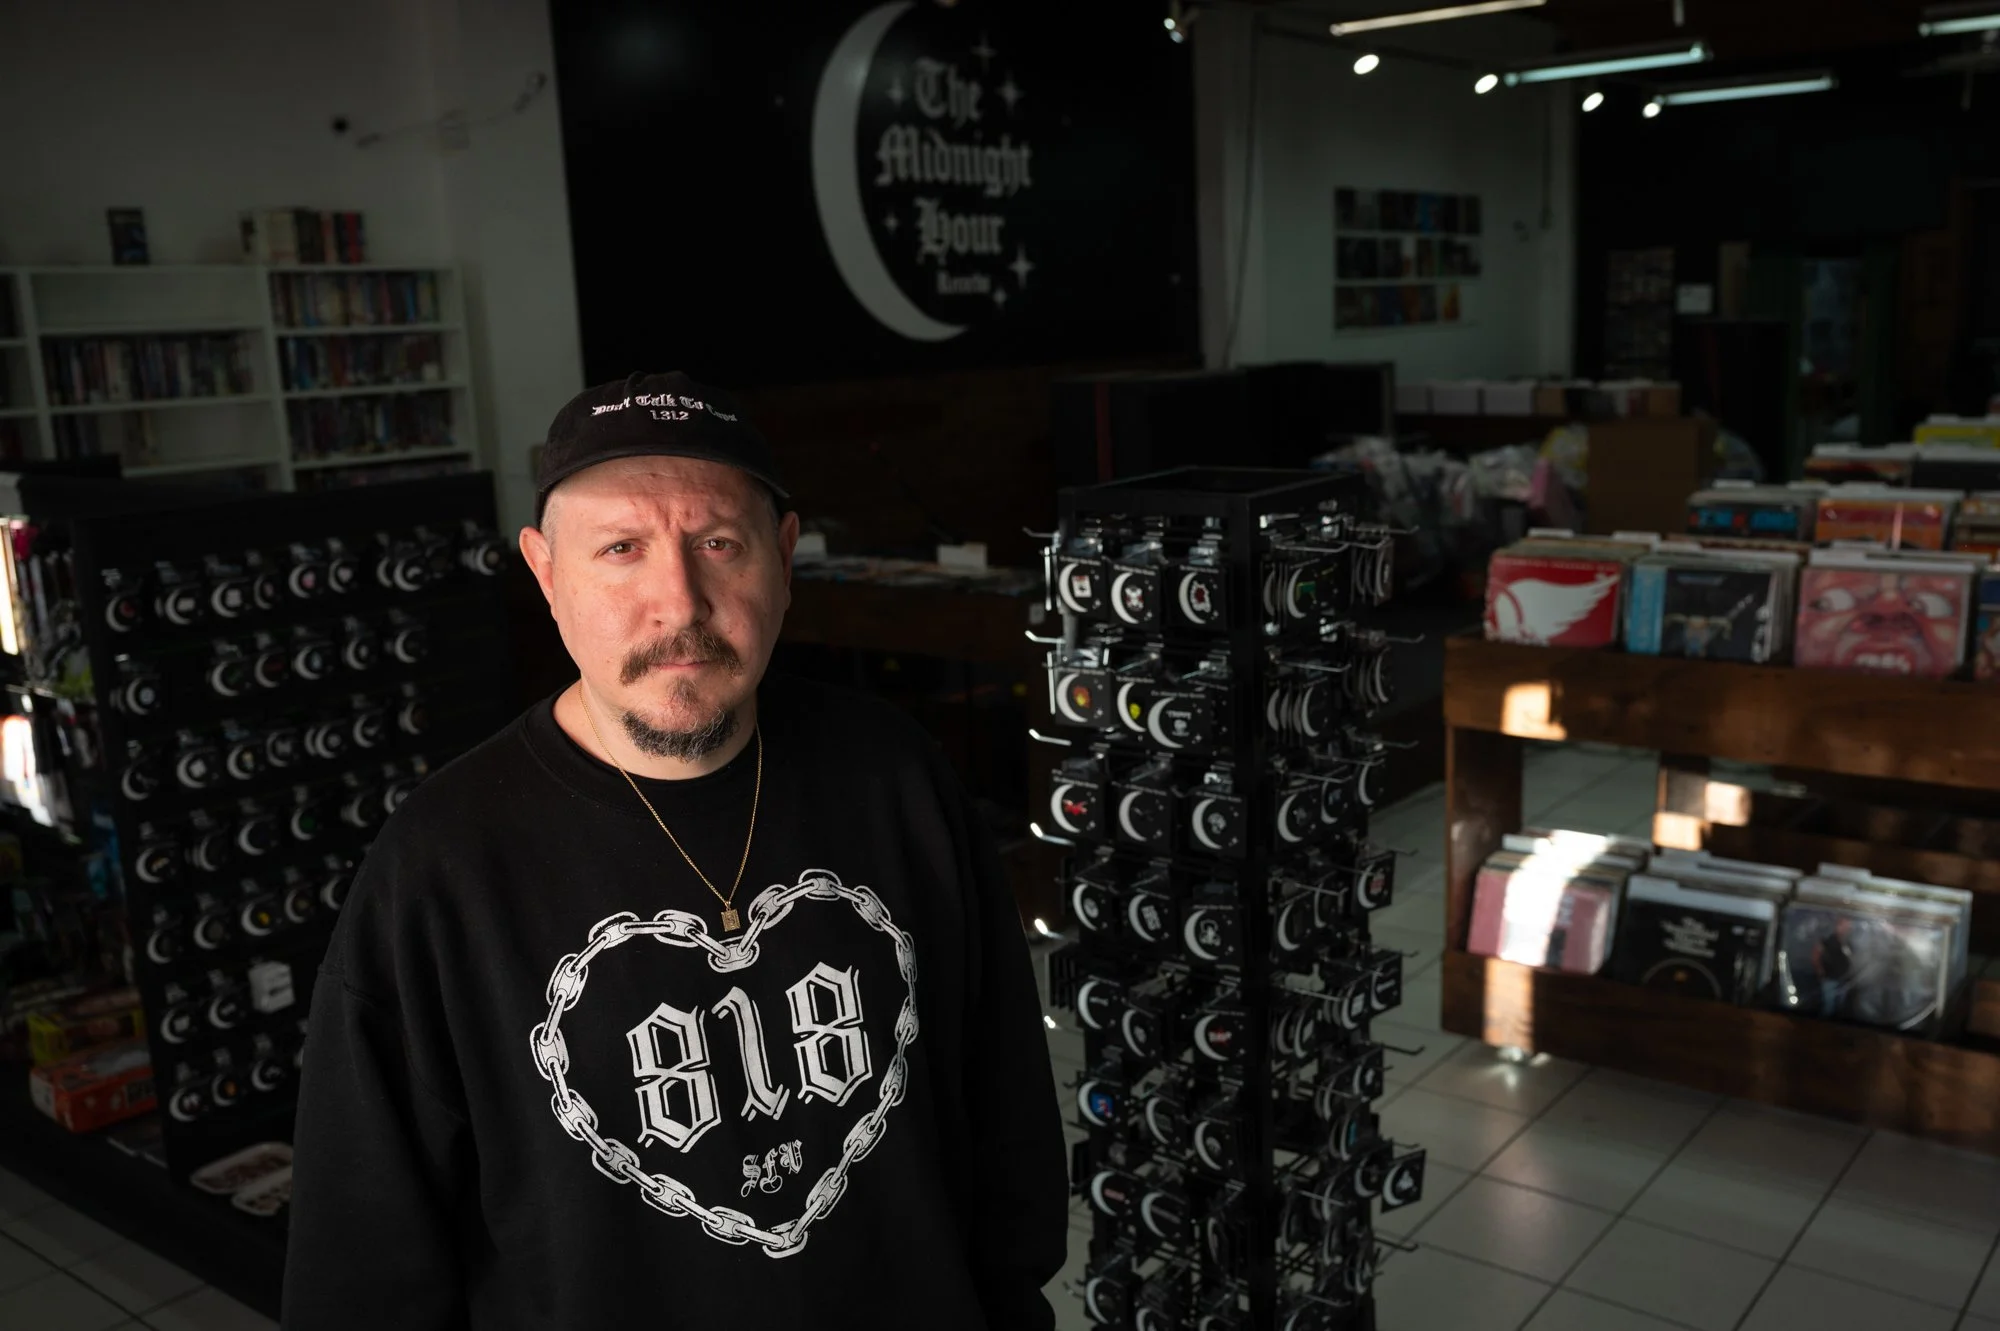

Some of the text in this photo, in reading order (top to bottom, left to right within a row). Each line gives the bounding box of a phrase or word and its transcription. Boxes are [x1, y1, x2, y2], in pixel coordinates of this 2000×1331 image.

[912, 55, 984, 128] The
[874, 124, 1033, 198] Midnight
[913, 196, 1005, 266] Hour
[634, 393, 678, 407] Talk
[679, 396, 704, 410] To
[626, 961, 873, 1153] 818
[741, 1139, 803, 1198] SFV
